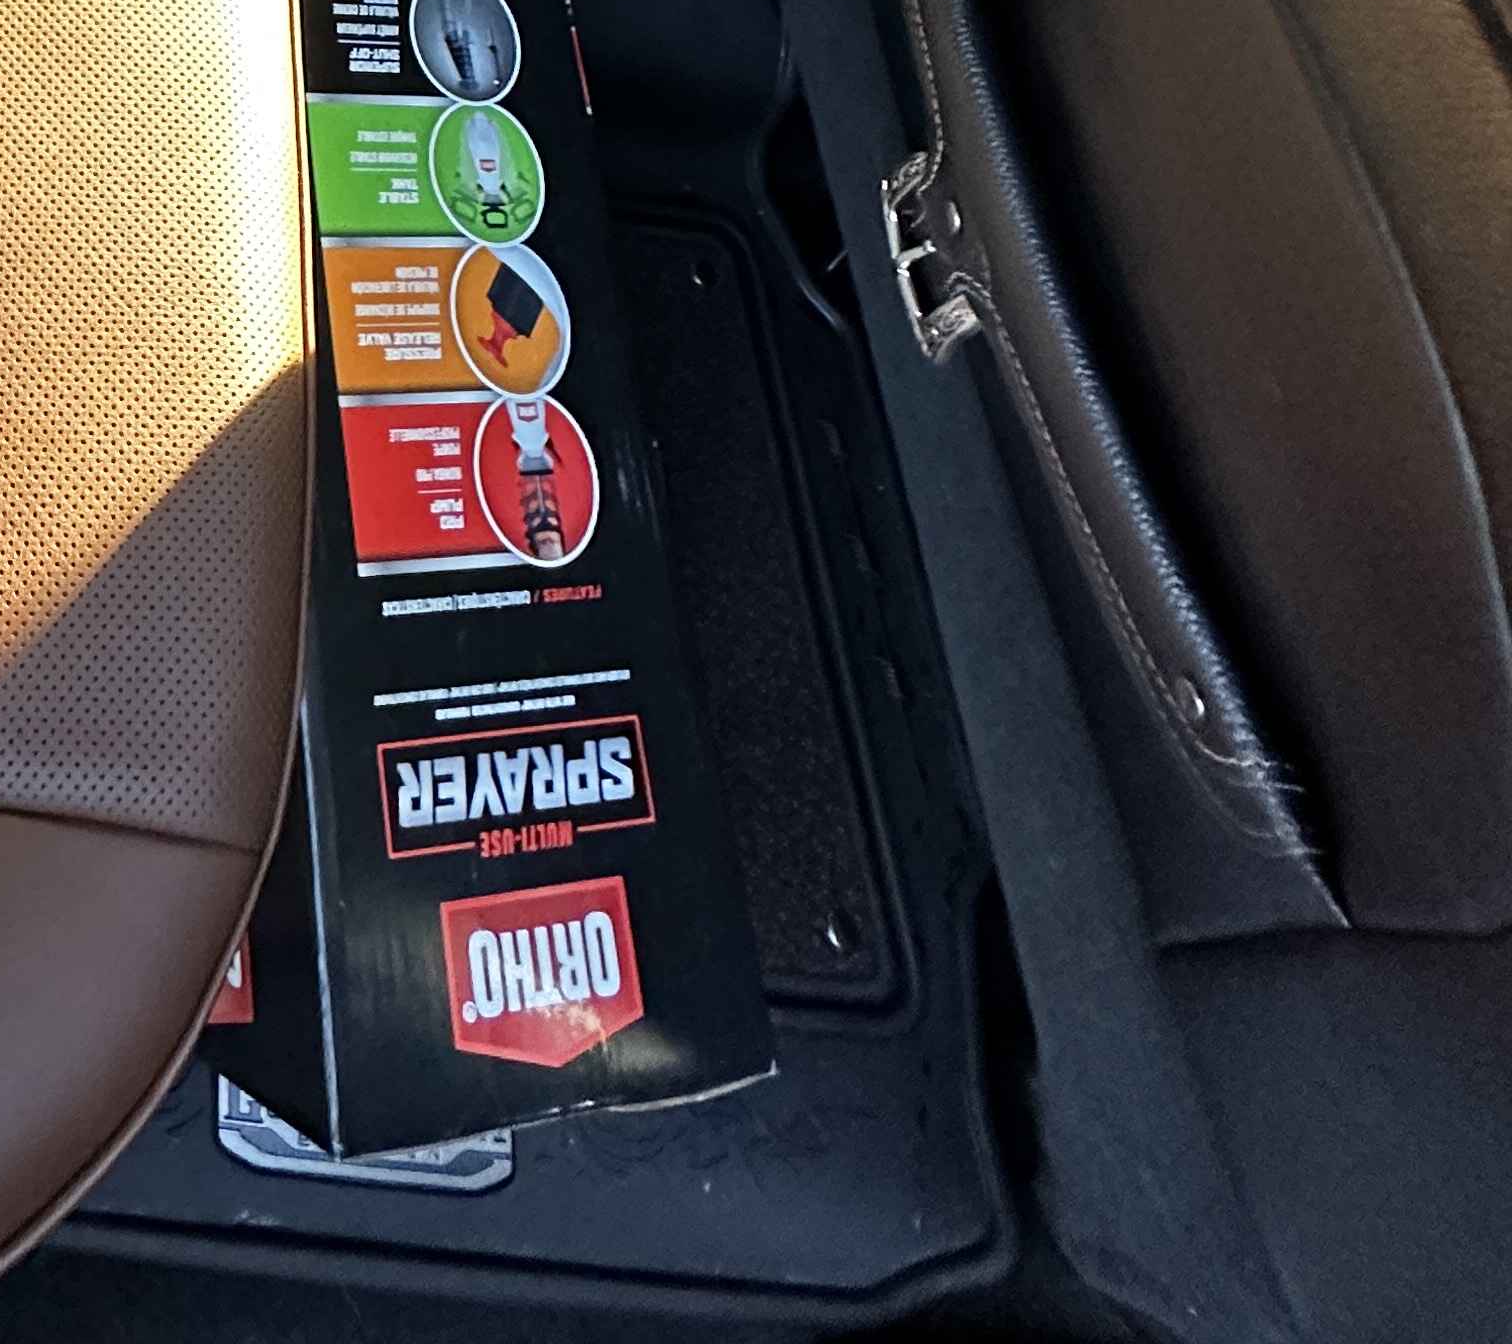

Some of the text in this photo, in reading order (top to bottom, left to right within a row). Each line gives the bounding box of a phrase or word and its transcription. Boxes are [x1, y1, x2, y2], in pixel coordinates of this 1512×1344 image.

[396, 736, 635, 828] SPRAYER
[480, 820, 573, 857] MULTI-USE
[467, 910, 620, 1019] ORTHO
